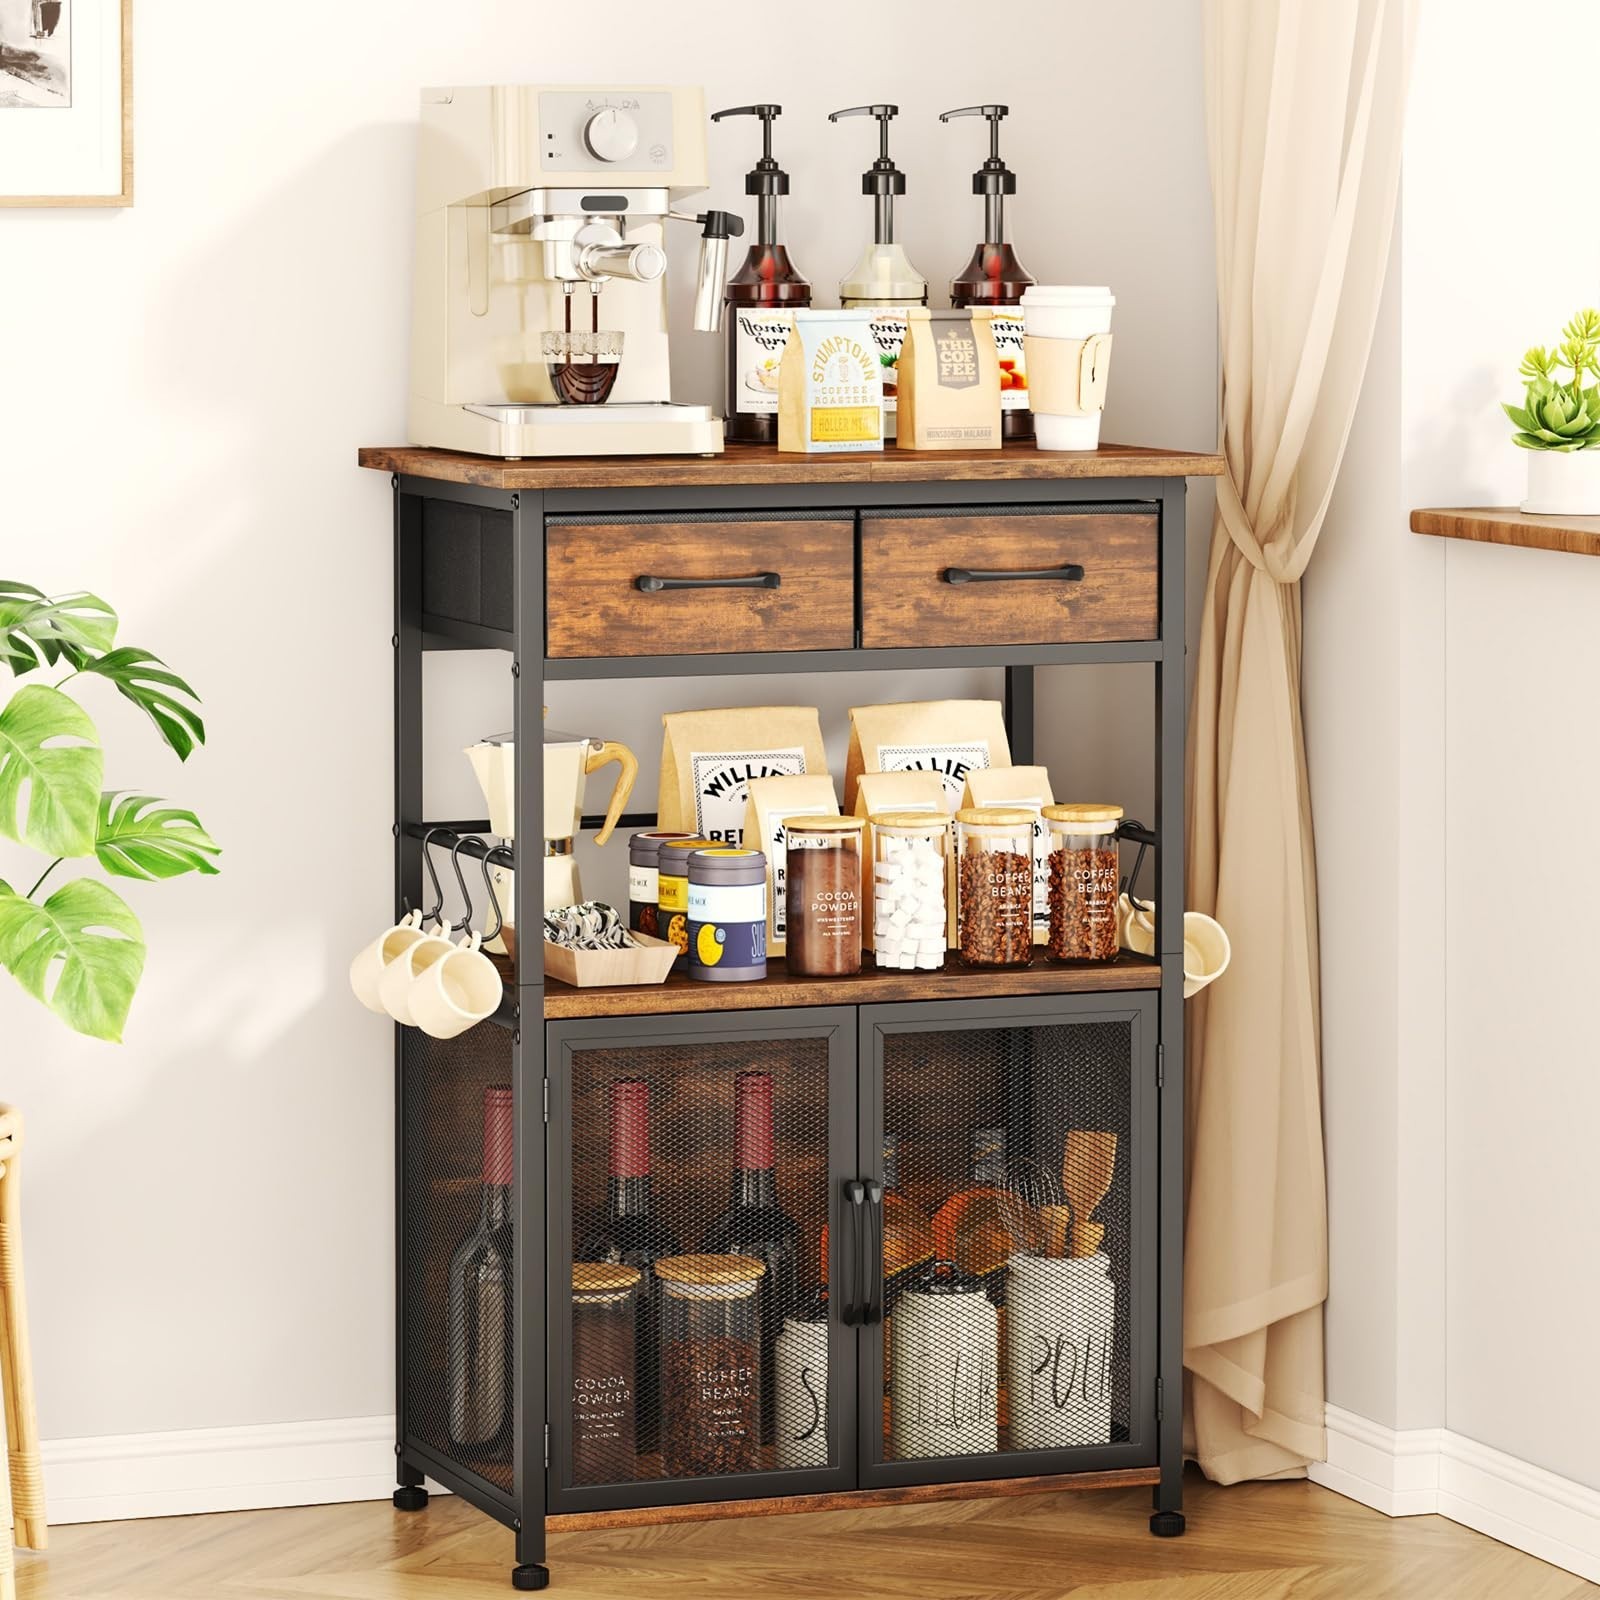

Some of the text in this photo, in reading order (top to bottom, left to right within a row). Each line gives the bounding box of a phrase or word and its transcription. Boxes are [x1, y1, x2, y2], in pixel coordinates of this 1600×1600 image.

[937, 339, 974, 351] THE
[812, 335, 877, 384] STUMPTOWN
[940, 350, 975, 363] COF
[940, 362, 977, 376] FEE
[821, 385, 868, 395] COFFEE
[815, 394, 876, 405] ROASTERS
[987, 870, 1029, 884] COFFEE
[1073, 868, 1115, 880] COFFEE
[991, 884, 1028, 897] BEANS
[1078, 881, 1113, 893] BEANS
[816, 891, 855, 902] COCOA
[811, 901, 858, 913] POWDER
[574, 1376, 626, 1390] COCOA
